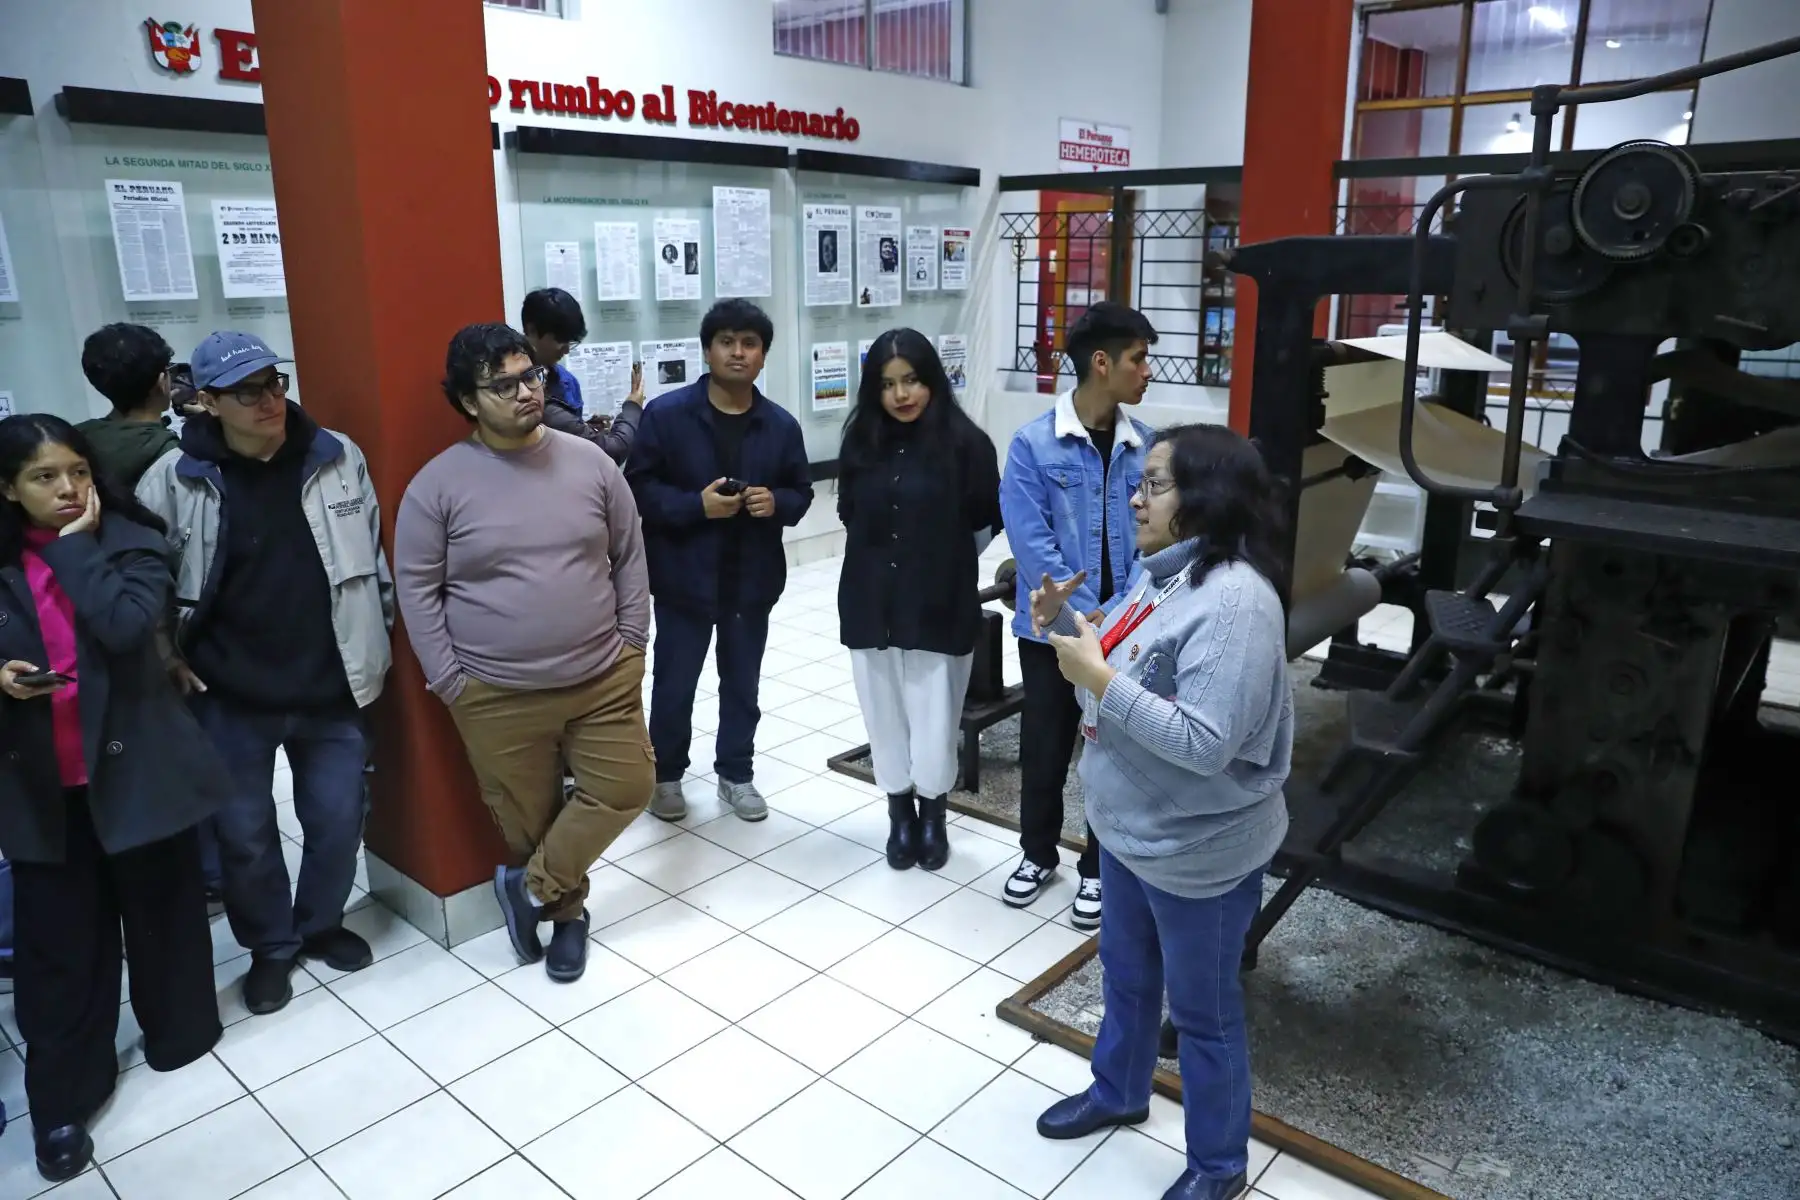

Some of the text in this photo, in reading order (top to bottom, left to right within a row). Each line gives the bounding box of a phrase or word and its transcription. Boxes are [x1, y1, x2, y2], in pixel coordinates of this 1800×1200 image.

[508, 76, 635, 118] rumbo
[642, 84, 677, 124] al
[687, 89, 860, 141] Bicentenario
[1079, 128, 1087, 140] El
[1060, 143, 1129, 165] HEMEROTECA
[104, 156, 120, 166] LA
[123, 157, 175, 168] SEGUNDA
[178, 159, 208, 170] MITAD
[211, 161, 230, 171] DEL
[233, 162, 262, 172] SIGLO
[114, 184, 175, 195] EL PERUANO
[222, 232, 229, 245] 2
[232, 233, 248, 245] DE
